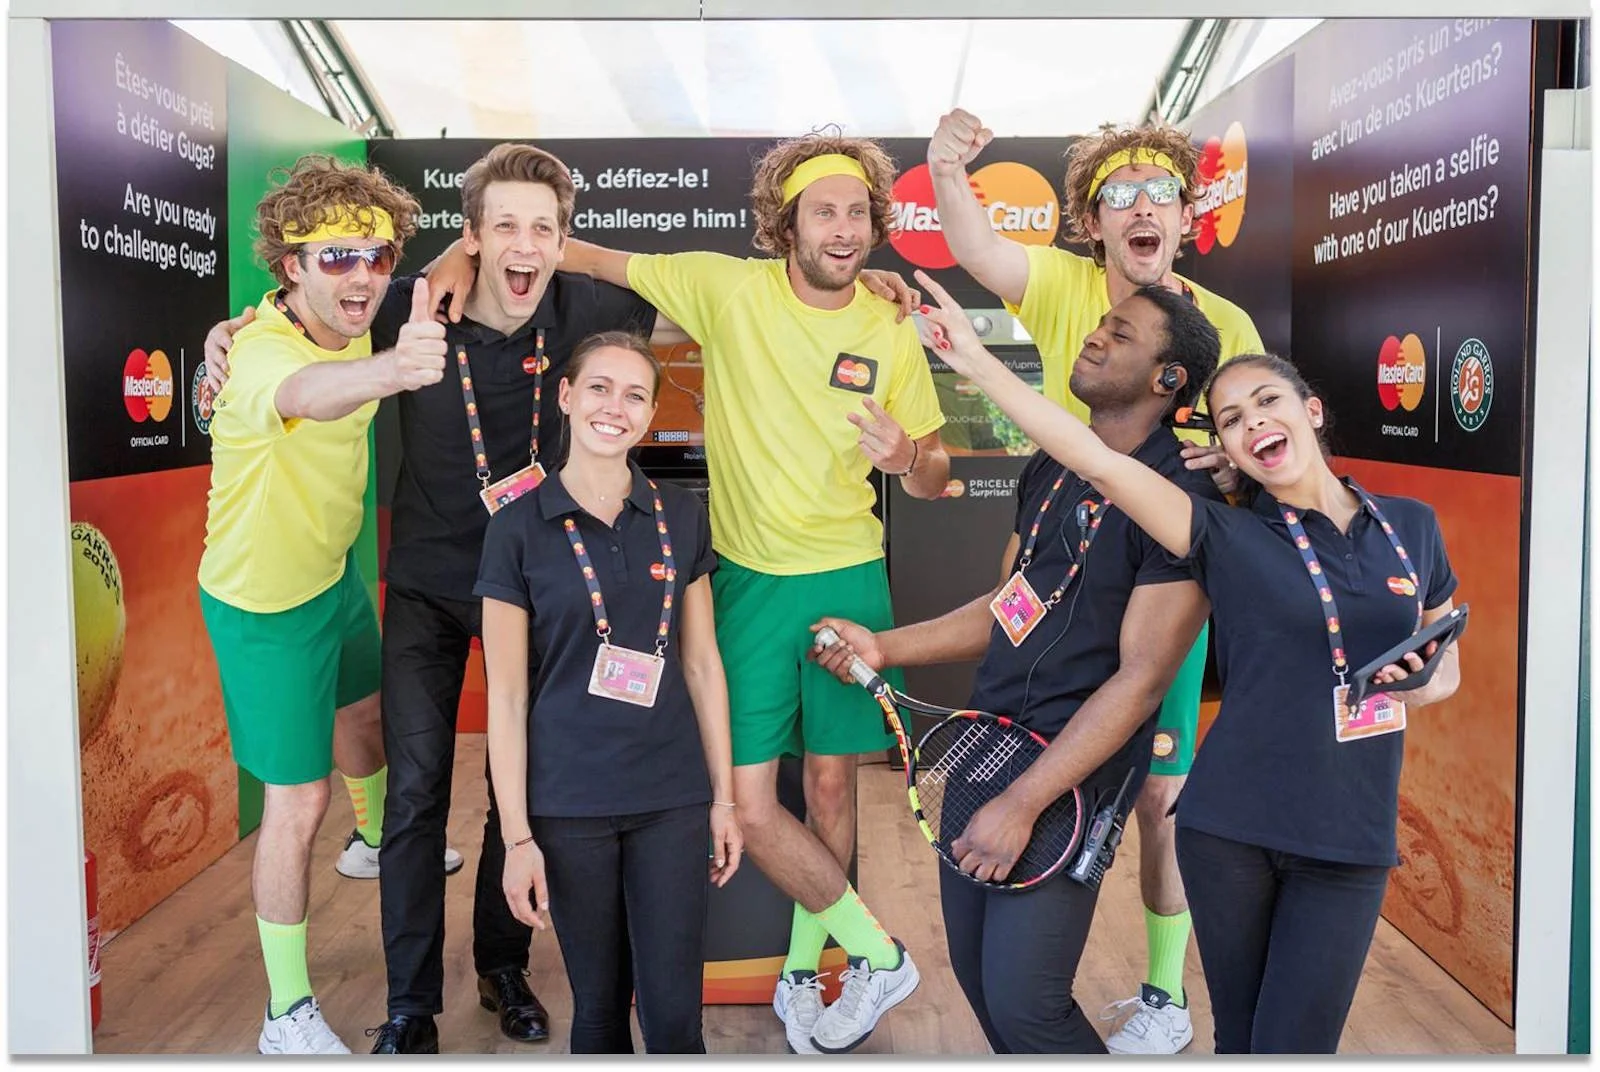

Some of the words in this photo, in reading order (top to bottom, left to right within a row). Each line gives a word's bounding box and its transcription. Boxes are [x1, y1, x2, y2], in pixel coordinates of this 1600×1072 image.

[115, 52, 188, 116] Êtes-vous
[190, 101, 215, 131] prêt
[1328, 57, 1394, 112] Avez-vous
[1397, 35, 1425, 82] pris
[1429, 25, 1449, 56] un
[1311, 128, 1338, 161] avec
[1340, 115, 1362, 149] l'un
[1365, 105, 1383, 135] de
[1386, 98, 1412, 128] nos
[1415, 42, 1503, 112] Kuertens?
[117, 105, 126, 135] à
[130, 114, 174, 153] défier
[177, 131, 215, 170] Guga?
[423, 168, 465, 189] Kue
[1329, 186, 1359, 220] Have
[1362, 178, 1386, 214] you
[1390, 161, 1431, 200] taken
[1435, 158, 1445, 183] a
[1449, 134, 1499, 178] selfie
[123, 183, 150, 217] Are
[154, 197, 180, 226] you
[183, 205, 216, 240] ready
[574, 207, 686, 233] challenge
[887, 201, 1054, 232] MasCard
[1313, 236, 1339, 265] with
[1341, 231, 1364, 258] one
[1367, 219, 1382, 250] of
[1384, 217, 1409, 245] our
[1412, 184, 1499, 239] Kuertens?
[80, 219, 99, 250] to
[104, 224, 176, 270] challenge
[180, 242, 217, 278] Guga?
[124, 375, 173, 397] MasterCard
[1378, 362, 1425, 385] MasterCard
